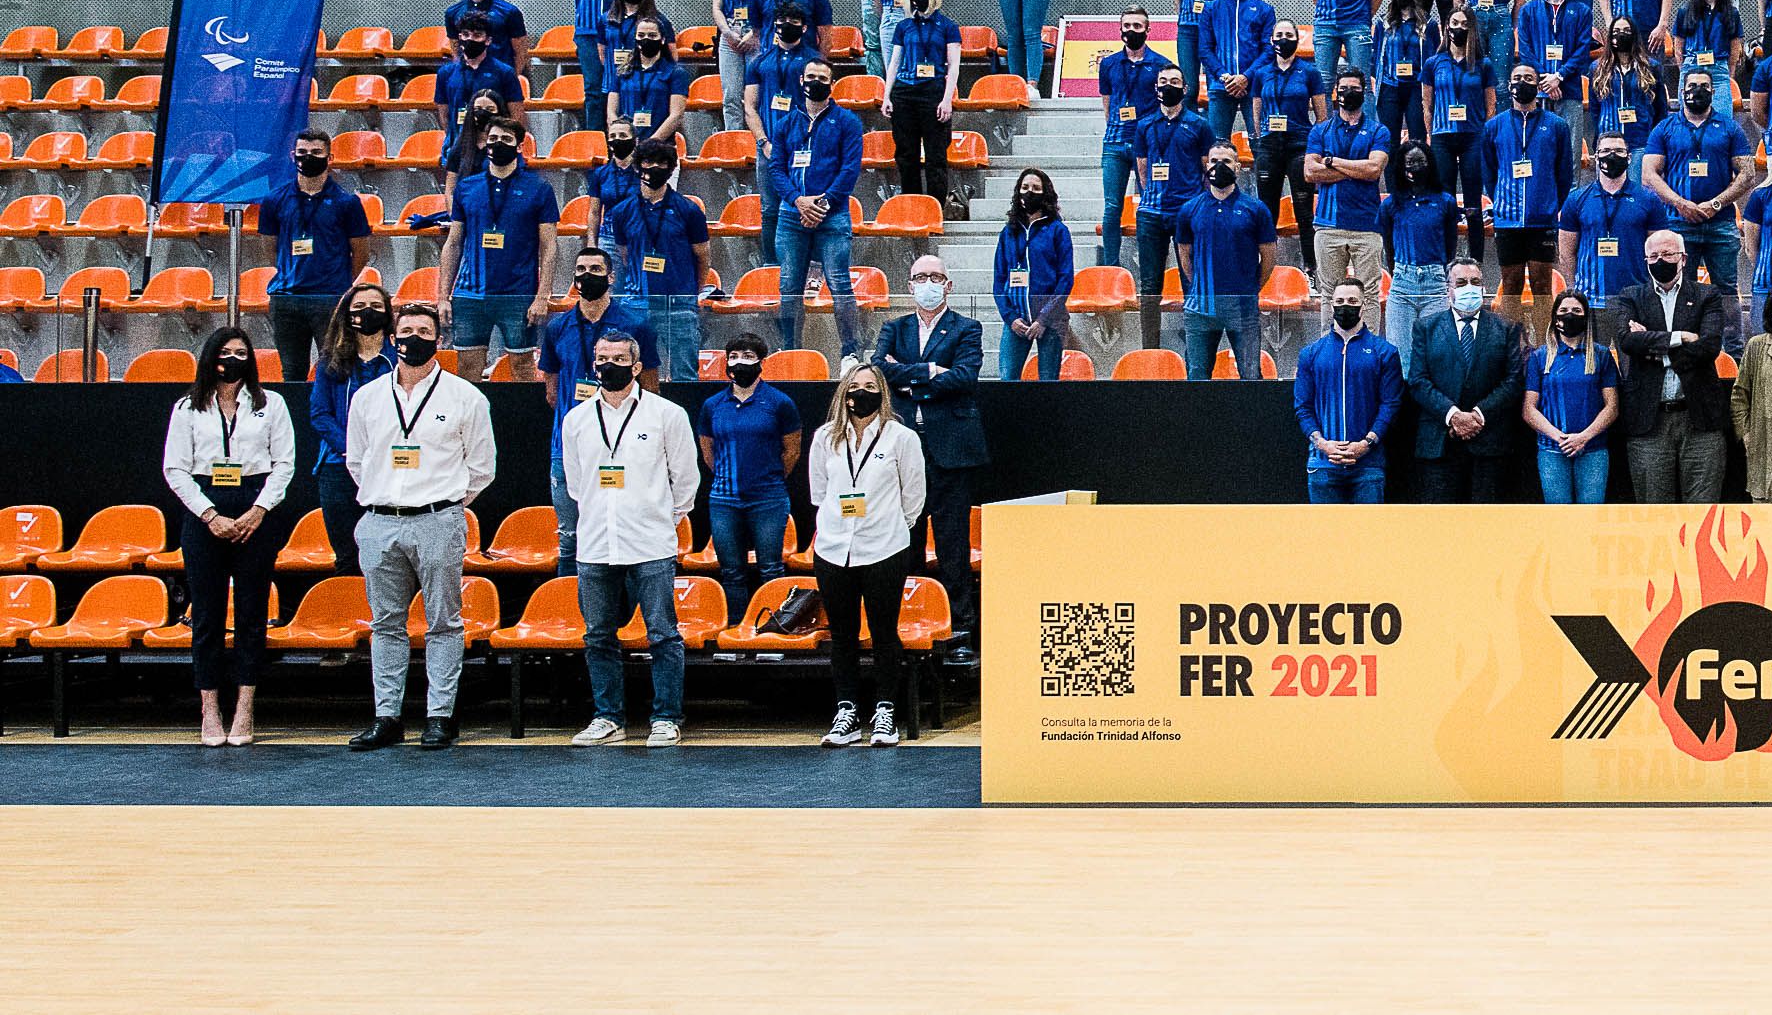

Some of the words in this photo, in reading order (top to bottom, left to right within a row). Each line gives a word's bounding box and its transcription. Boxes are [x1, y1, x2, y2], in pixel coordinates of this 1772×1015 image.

[255, 57, 284, 66] Comité
[254, 71, 284, 79] Español
[1180, 602, 1402, 646] PROYECTO
[1180, 655, 1254, 697] FER
[1269, 654, 1378, 697] 2021
[1041, 717, 1086, 727] Consulta
[1088, 717, 1097, 727] la
[1100, 717, 1145, 727] memoria
[1148, 717, 1160, 727] de
[1162, 717, 1172, 727] la
[1041, 731, 1094, 741] Fundación
[1096, 731, 1138, 741] Trinidad
[1141, 731, 1182, 741] Alfonso
